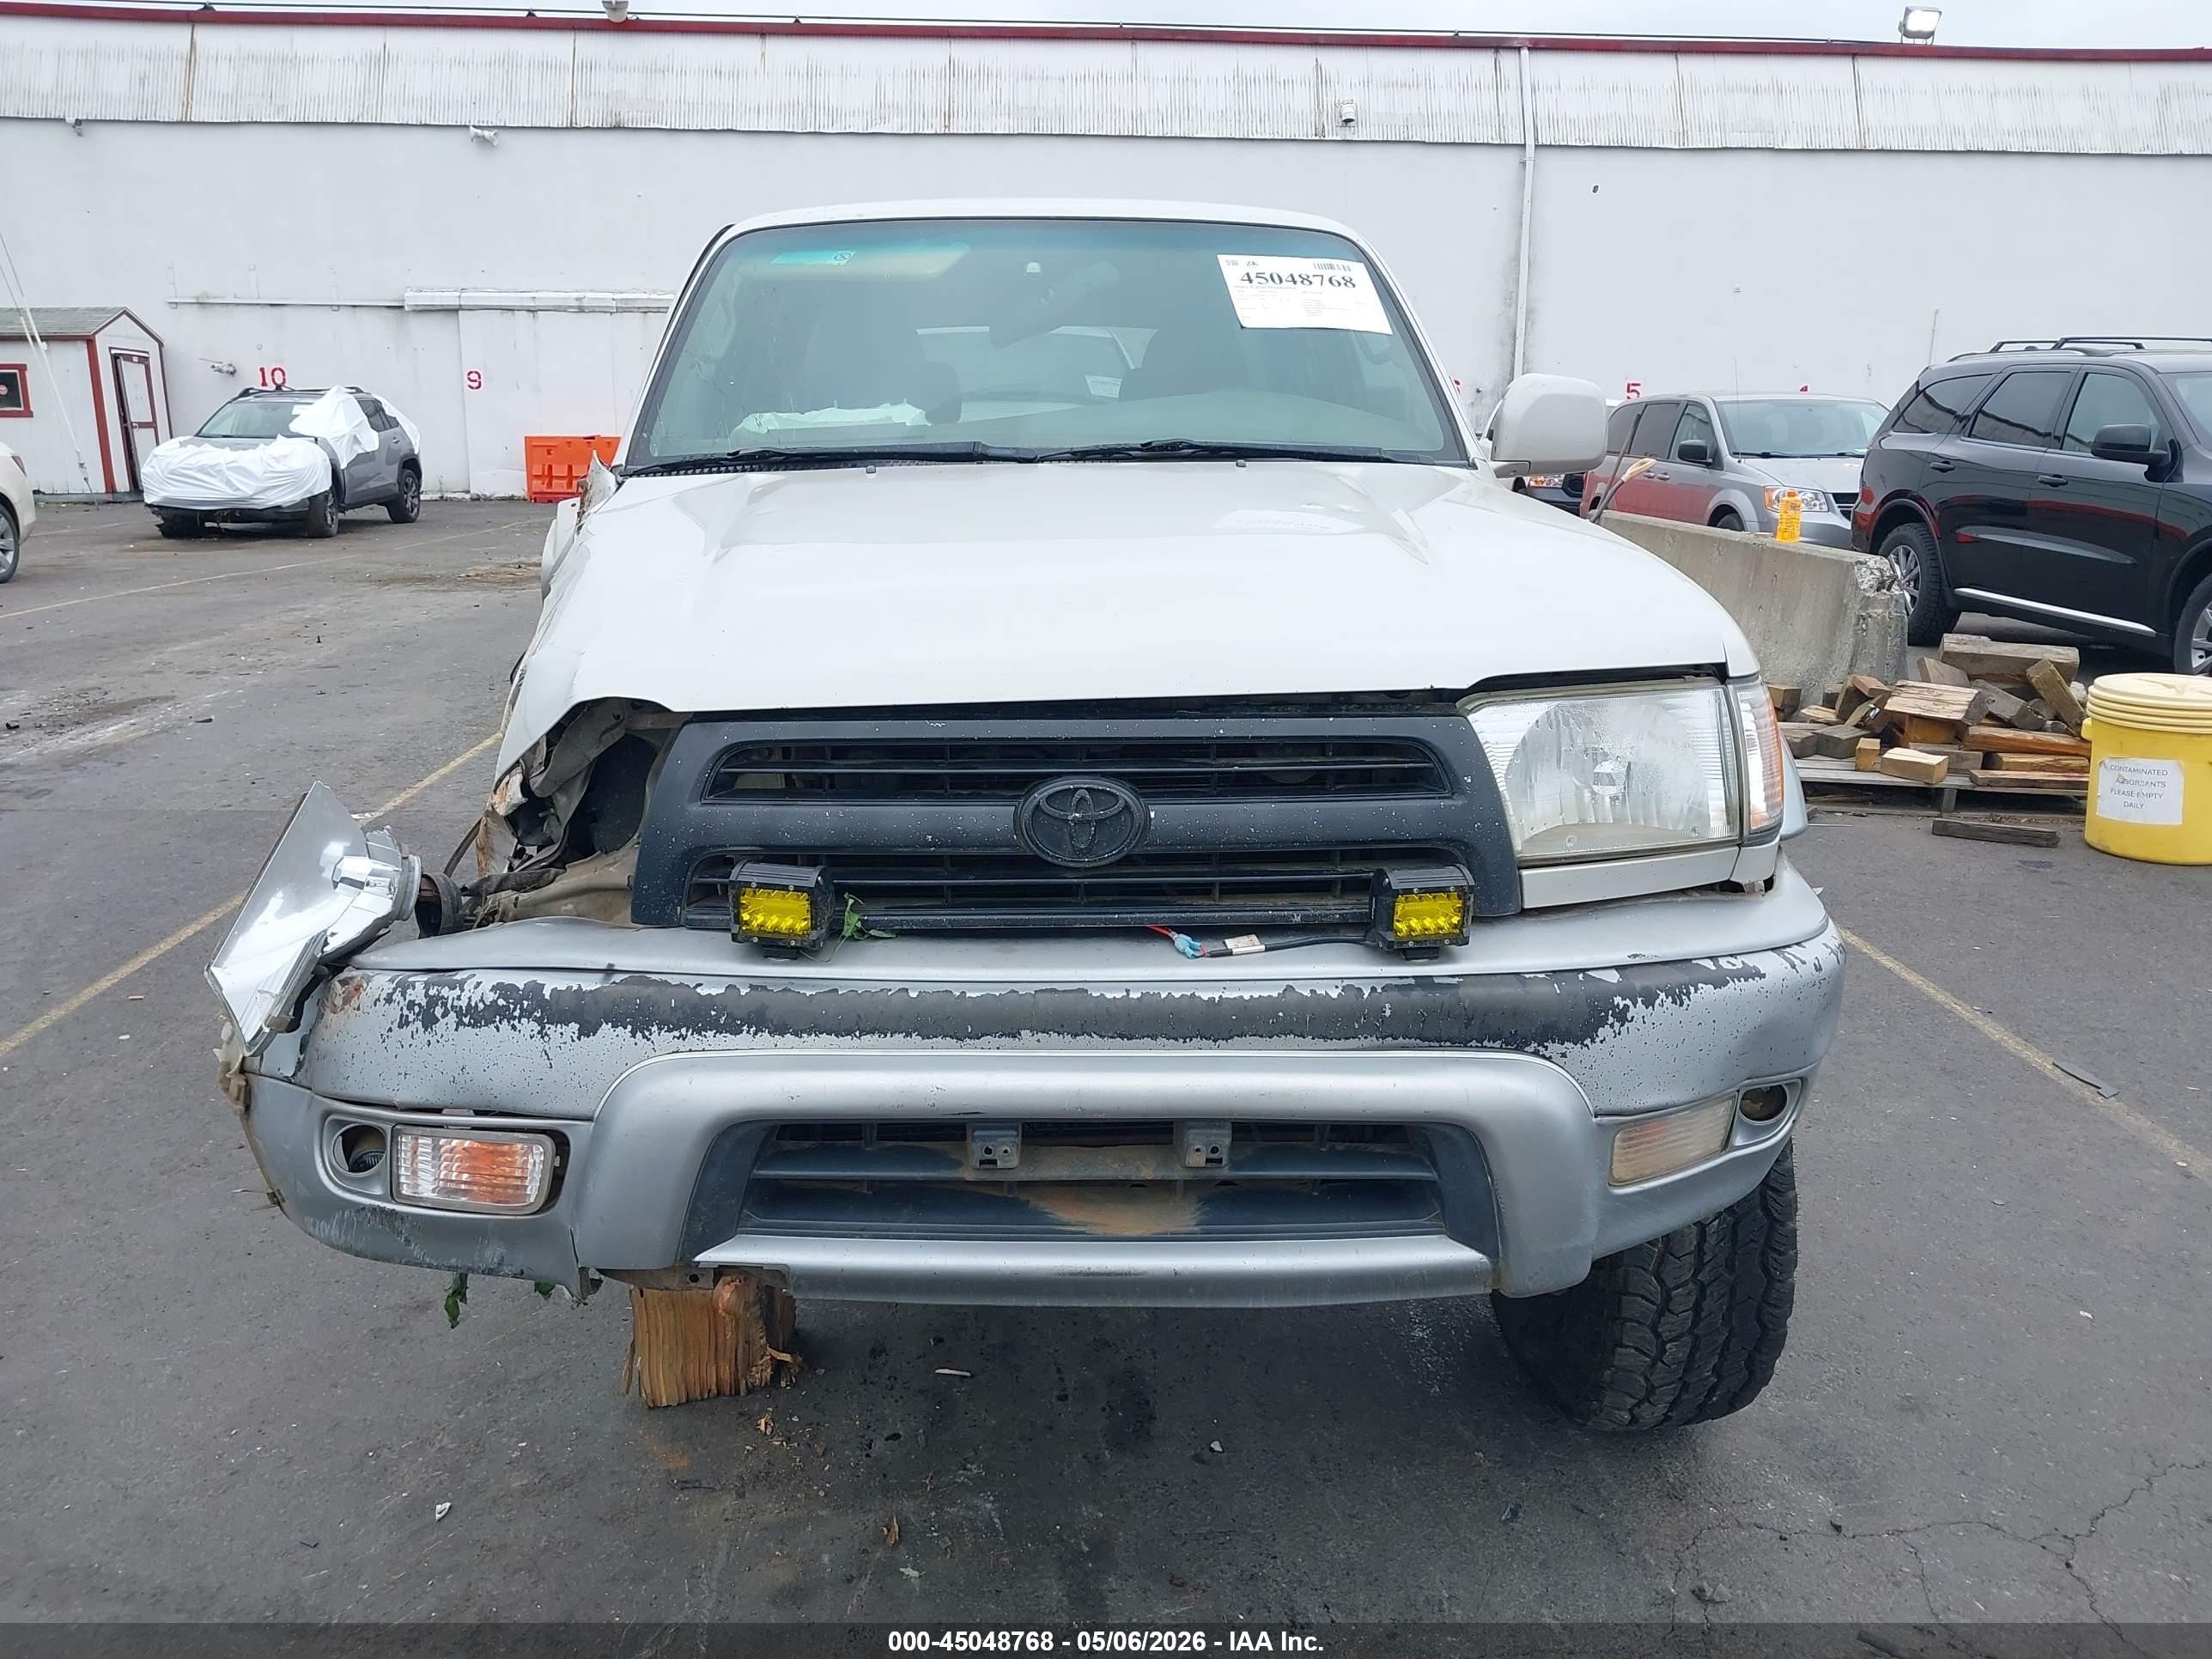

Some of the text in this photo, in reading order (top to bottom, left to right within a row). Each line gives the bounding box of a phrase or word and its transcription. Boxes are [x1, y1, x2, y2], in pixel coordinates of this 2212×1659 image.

[1240, 271, 1357, 289] 45048768
[258, 367, 287, 387] 10
[466, 370, 482, 390] 9
[1626, 382, 1642, 400] 5
[2110, 764, 2169, 776] CONTAMINATED
[2116, 775, 2166, 788] ASORBANTS
[2110, 788, 2164, 800] PLEASE EMPTY
[2123, 800, 2145, 810] DAILY
